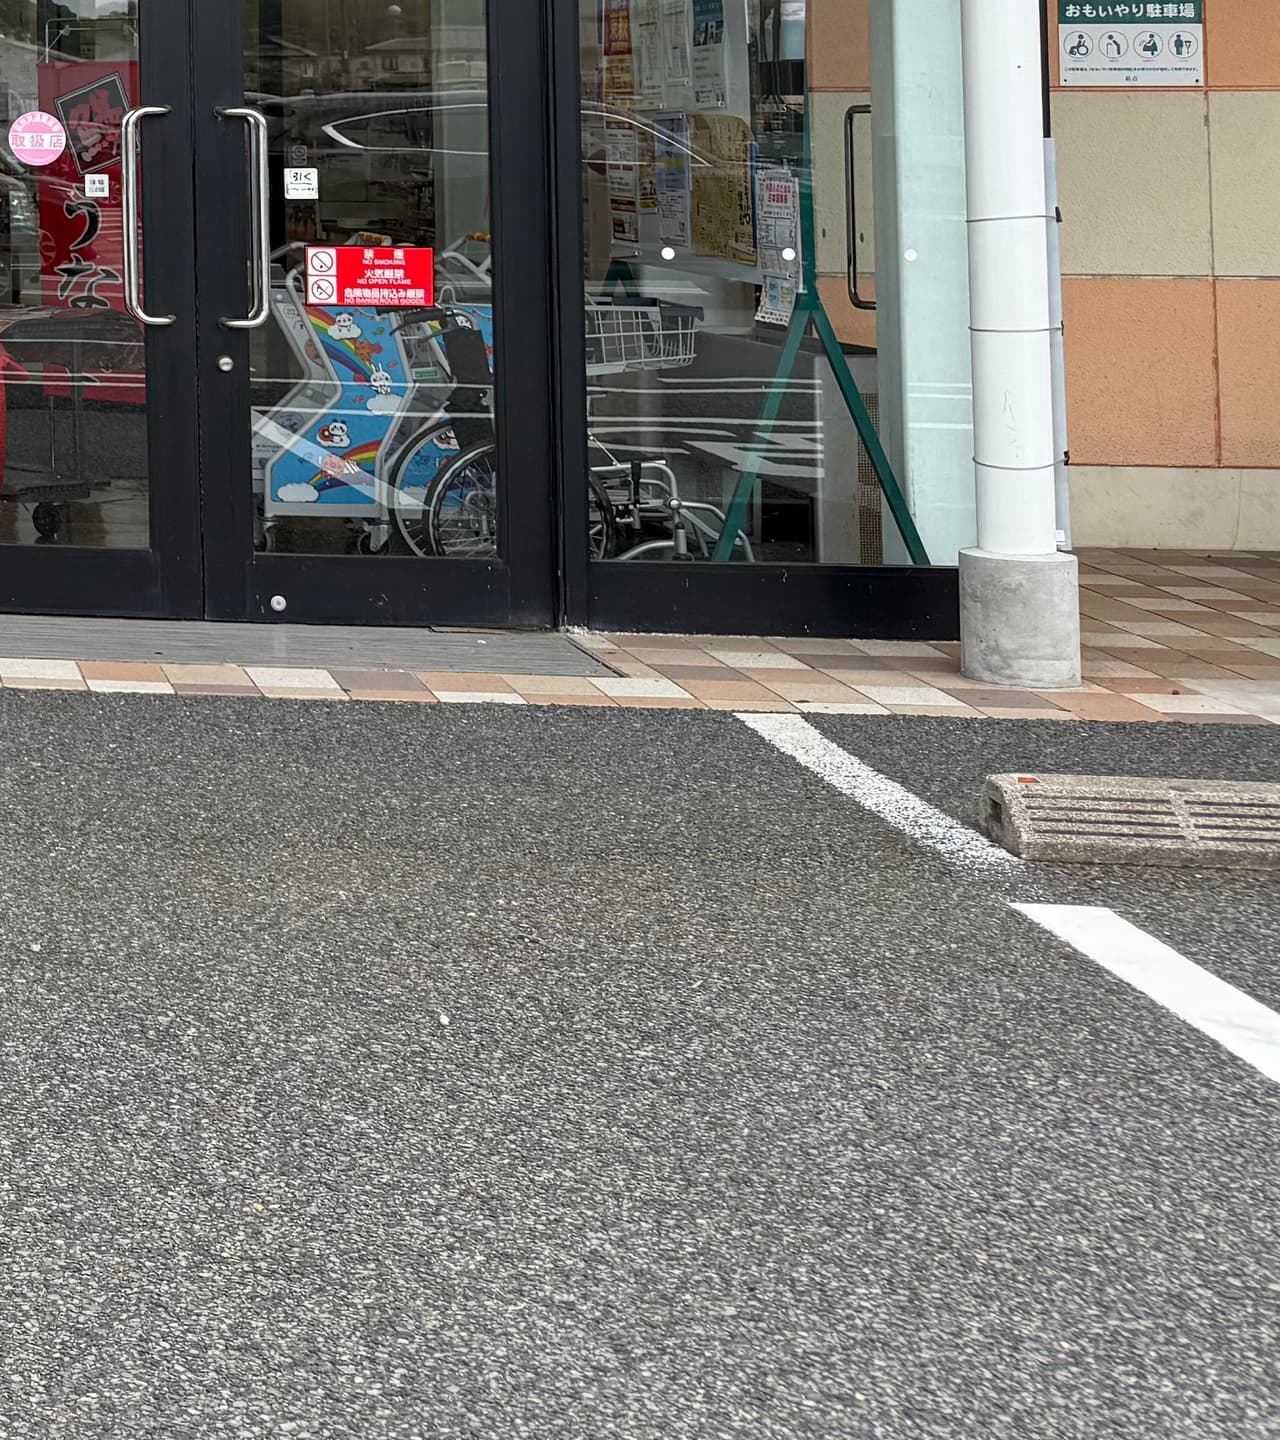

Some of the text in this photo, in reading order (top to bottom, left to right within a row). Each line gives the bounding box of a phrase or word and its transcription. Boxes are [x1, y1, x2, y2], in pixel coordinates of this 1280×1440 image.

[1065, 3, 1195, 19] おもいやり駐車場
[11, 134, 64, 149] 取扱店
